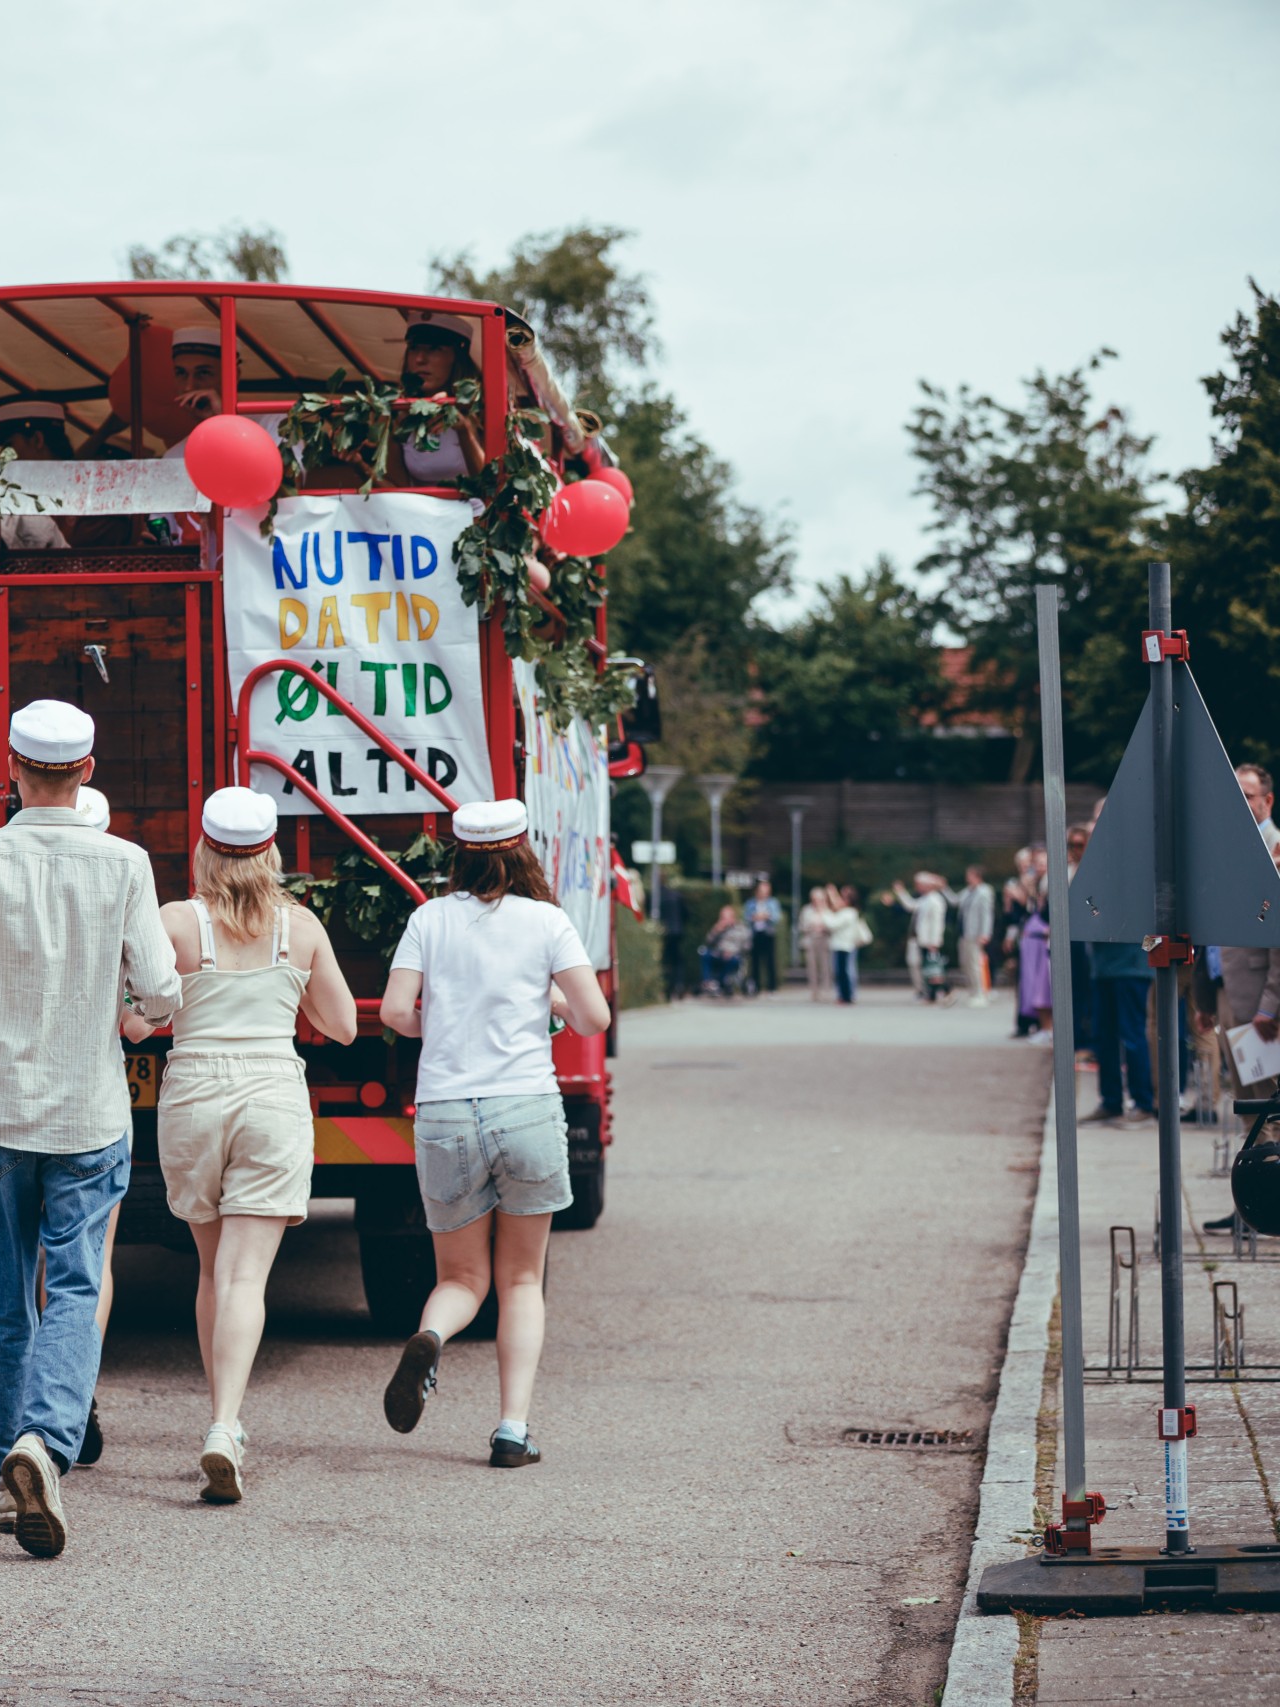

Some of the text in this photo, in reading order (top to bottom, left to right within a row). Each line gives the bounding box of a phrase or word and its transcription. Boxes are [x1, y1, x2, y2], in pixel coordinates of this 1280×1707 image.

[272, 530, 438, 590] NUTID
[279, 591, 440, 650] DATID
[274, 660, 452, 725] ØLTID
[282, 746, 458, 796] ALTID
[124, 1057, 151, 1080] 78
[129, 1082, 140, 1104] 9
